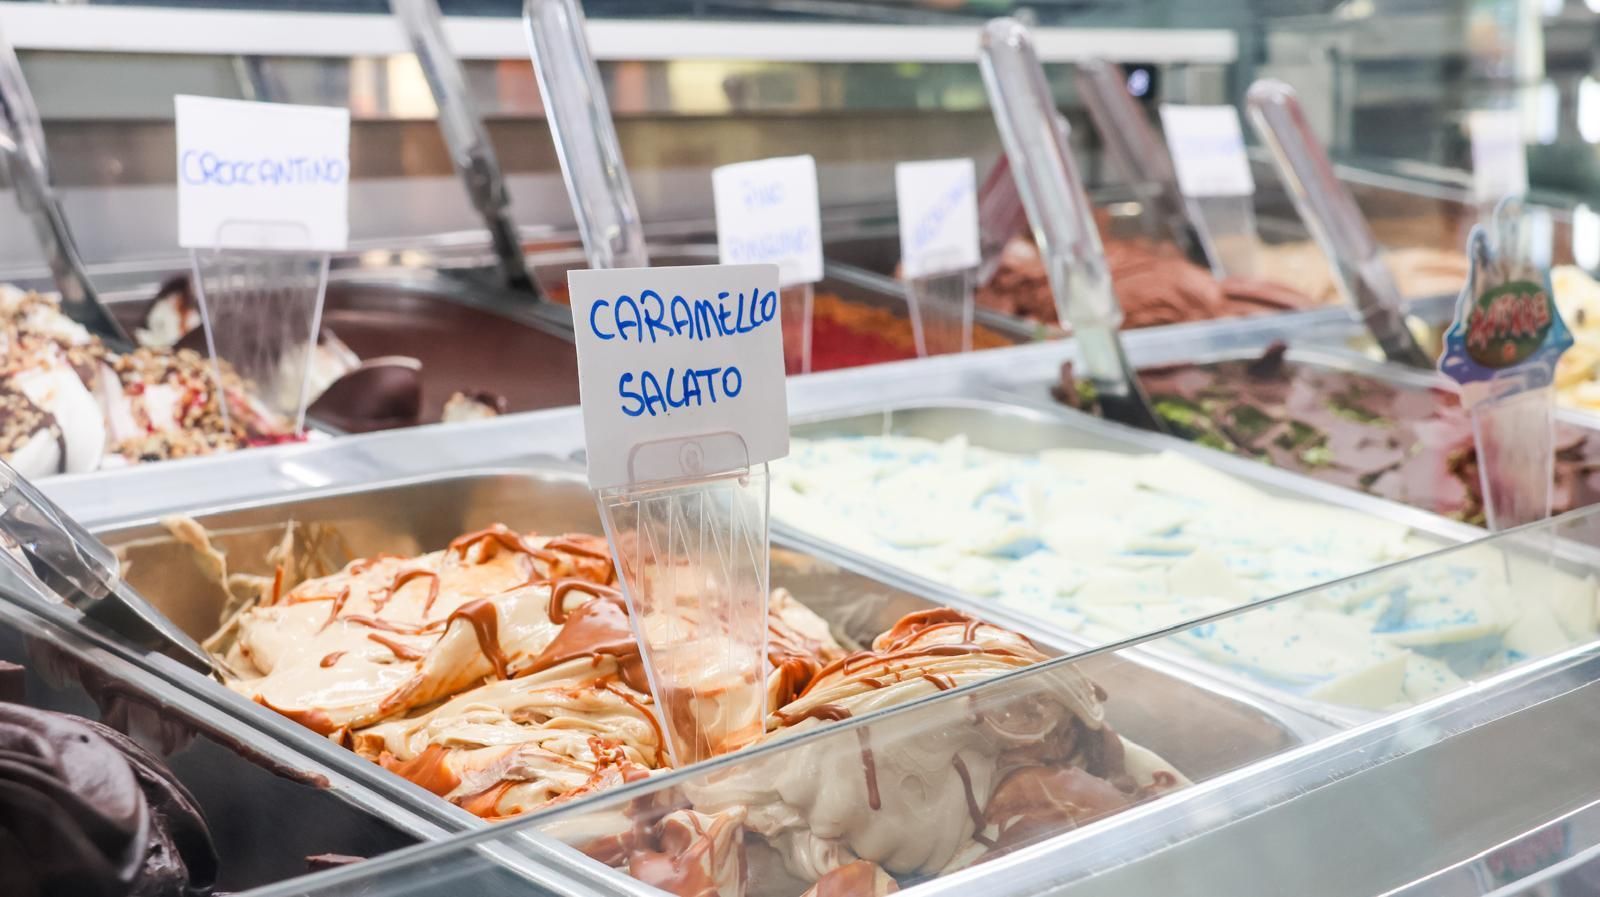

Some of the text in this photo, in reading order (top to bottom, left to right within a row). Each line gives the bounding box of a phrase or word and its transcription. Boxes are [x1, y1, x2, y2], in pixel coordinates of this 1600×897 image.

[182, 149, 346, 186] CROCCANTINO
[589, 287, 777, 343] CARAMELLO
[618, 366, 743, 417] SALATO
